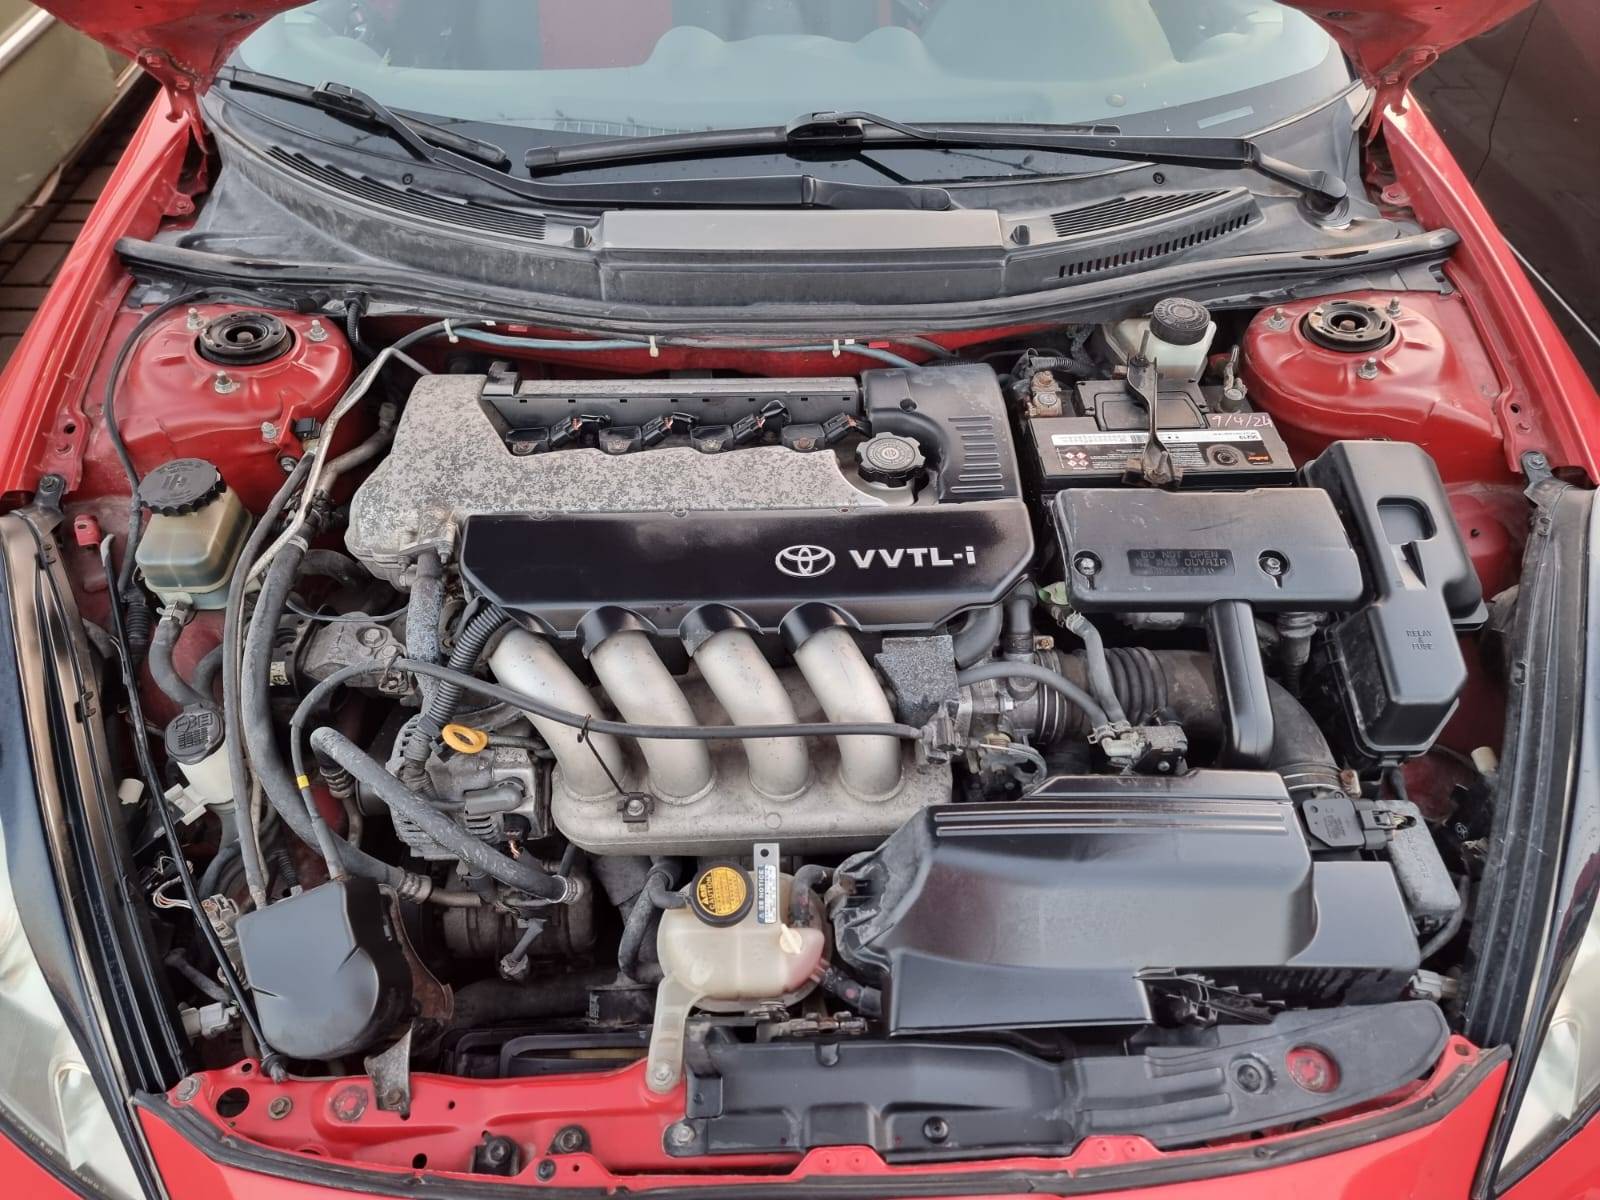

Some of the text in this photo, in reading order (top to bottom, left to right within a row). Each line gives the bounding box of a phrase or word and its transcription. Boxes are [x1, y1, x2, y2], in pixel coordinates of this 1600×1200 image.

[849, 546, 976, 569] VVTL-i
[1162, 551, 1182, 559] NOT
[705, 876, 716, 911] CAUTION
